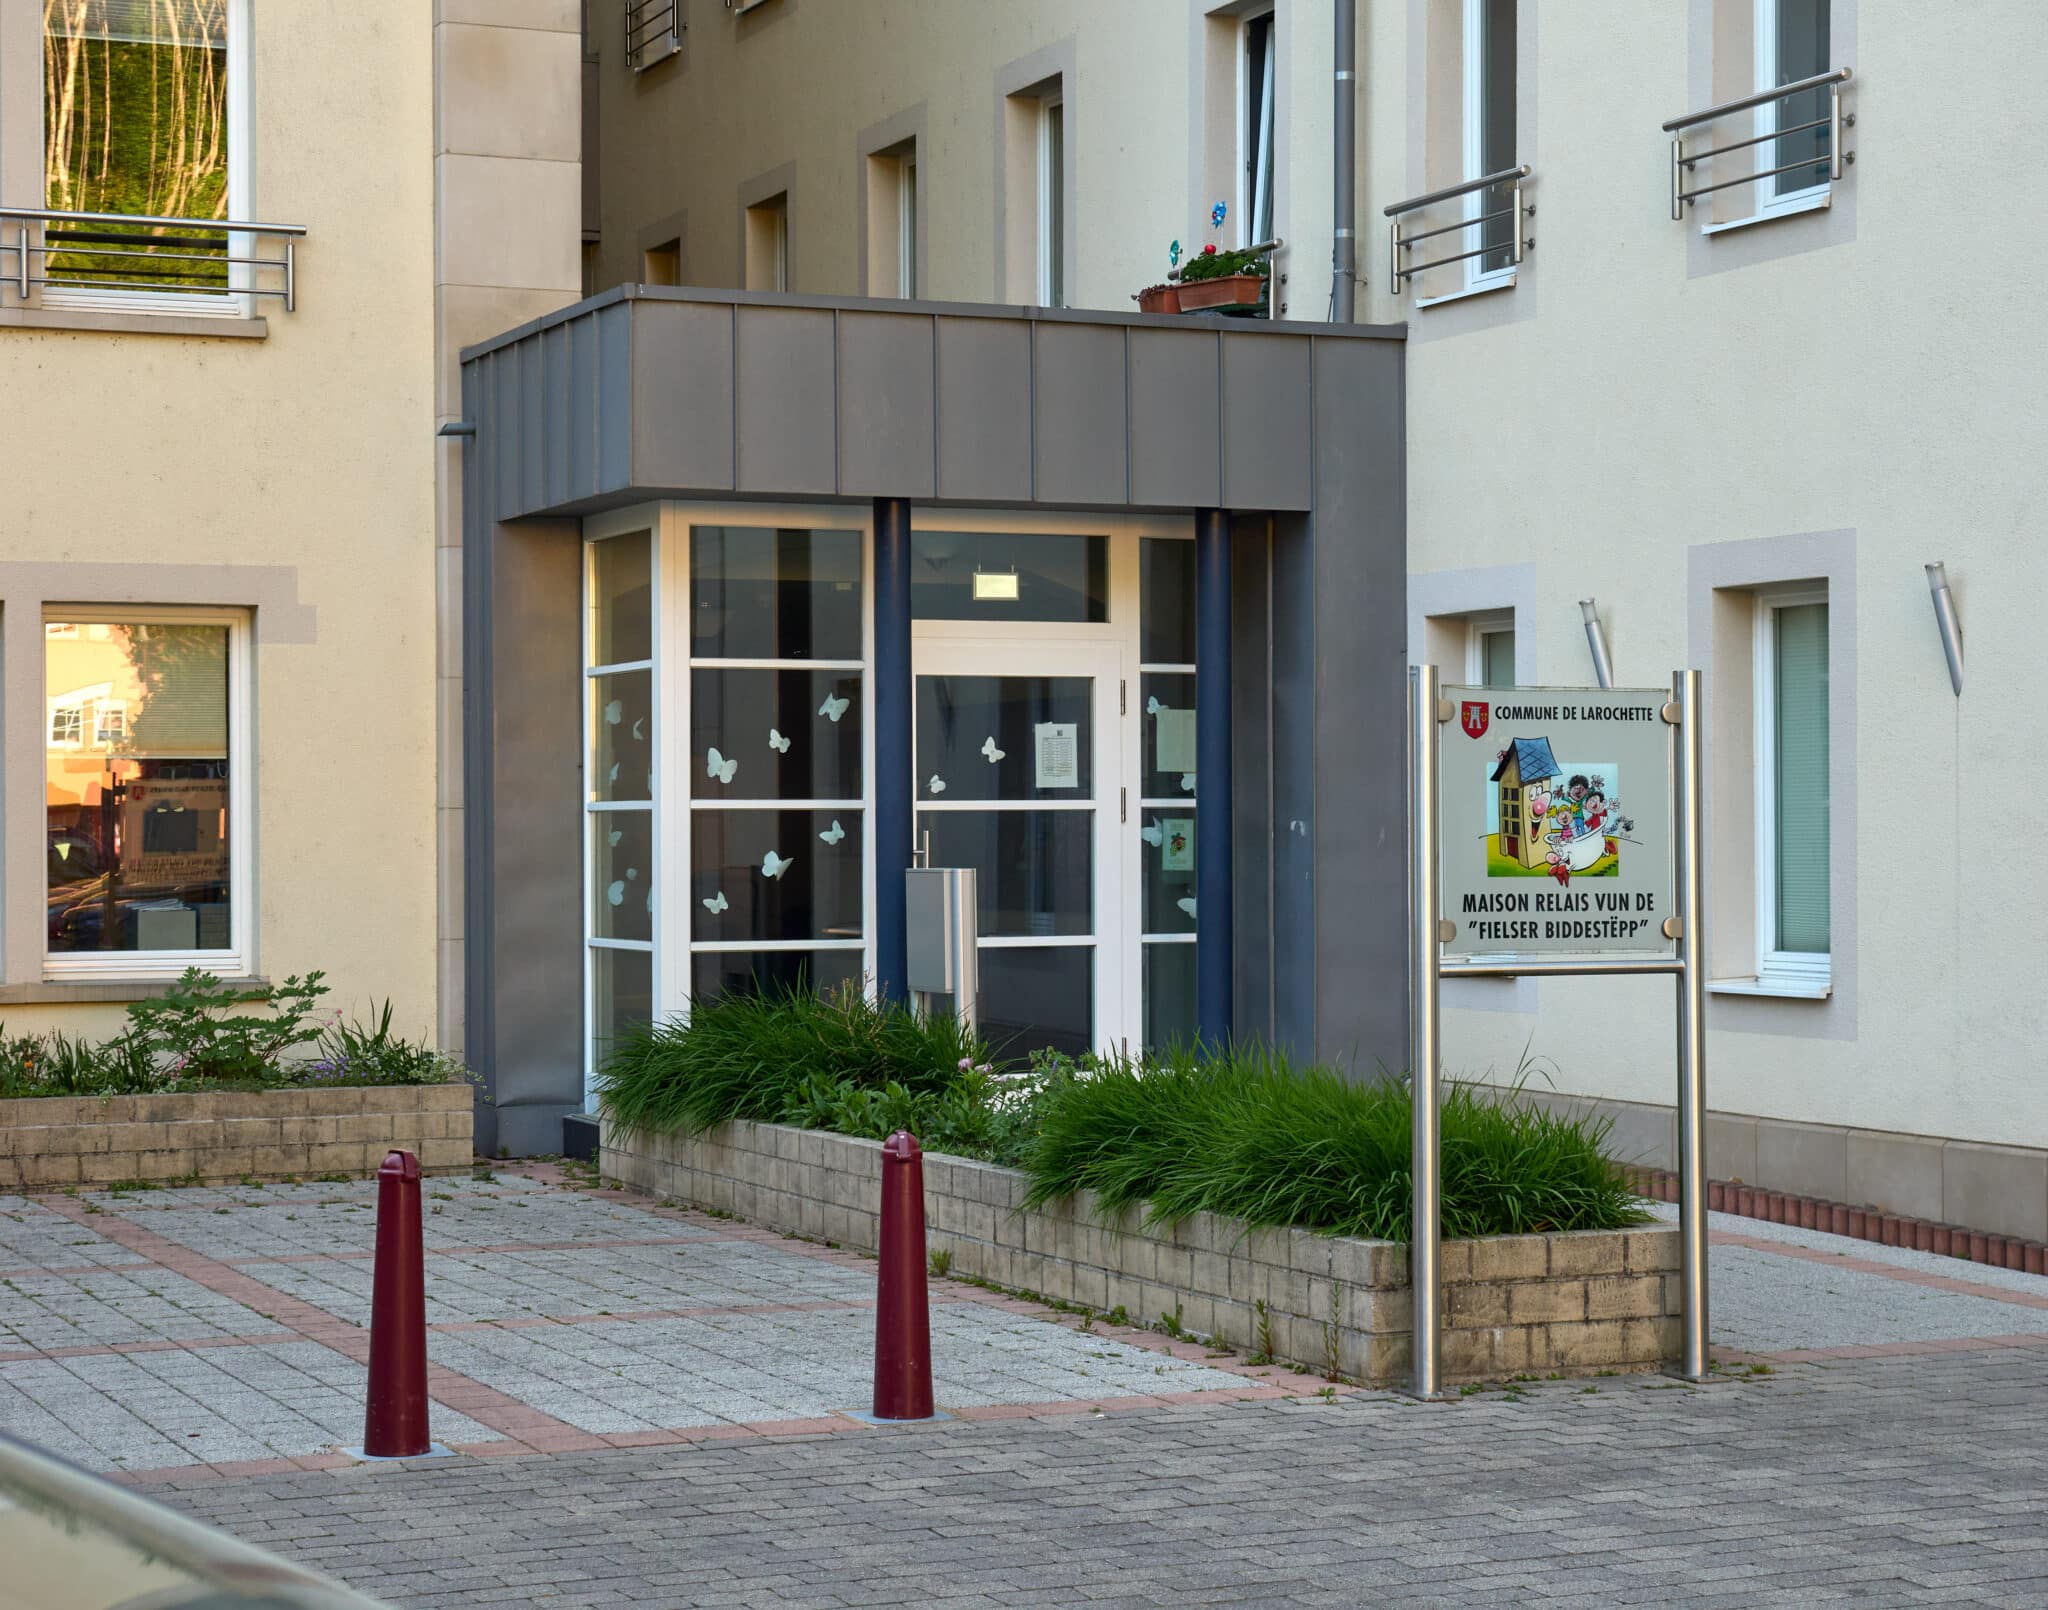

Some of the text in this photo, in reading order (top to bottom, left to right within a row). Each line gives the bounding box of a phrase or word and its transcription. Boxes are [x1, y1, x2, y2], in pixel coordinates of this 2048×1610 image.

[1495, 706, 1653, 721] COMMUNE DE LAROCHETTE
[1462, 893, 1654, 912] MAISON RELAIS VUN DE
